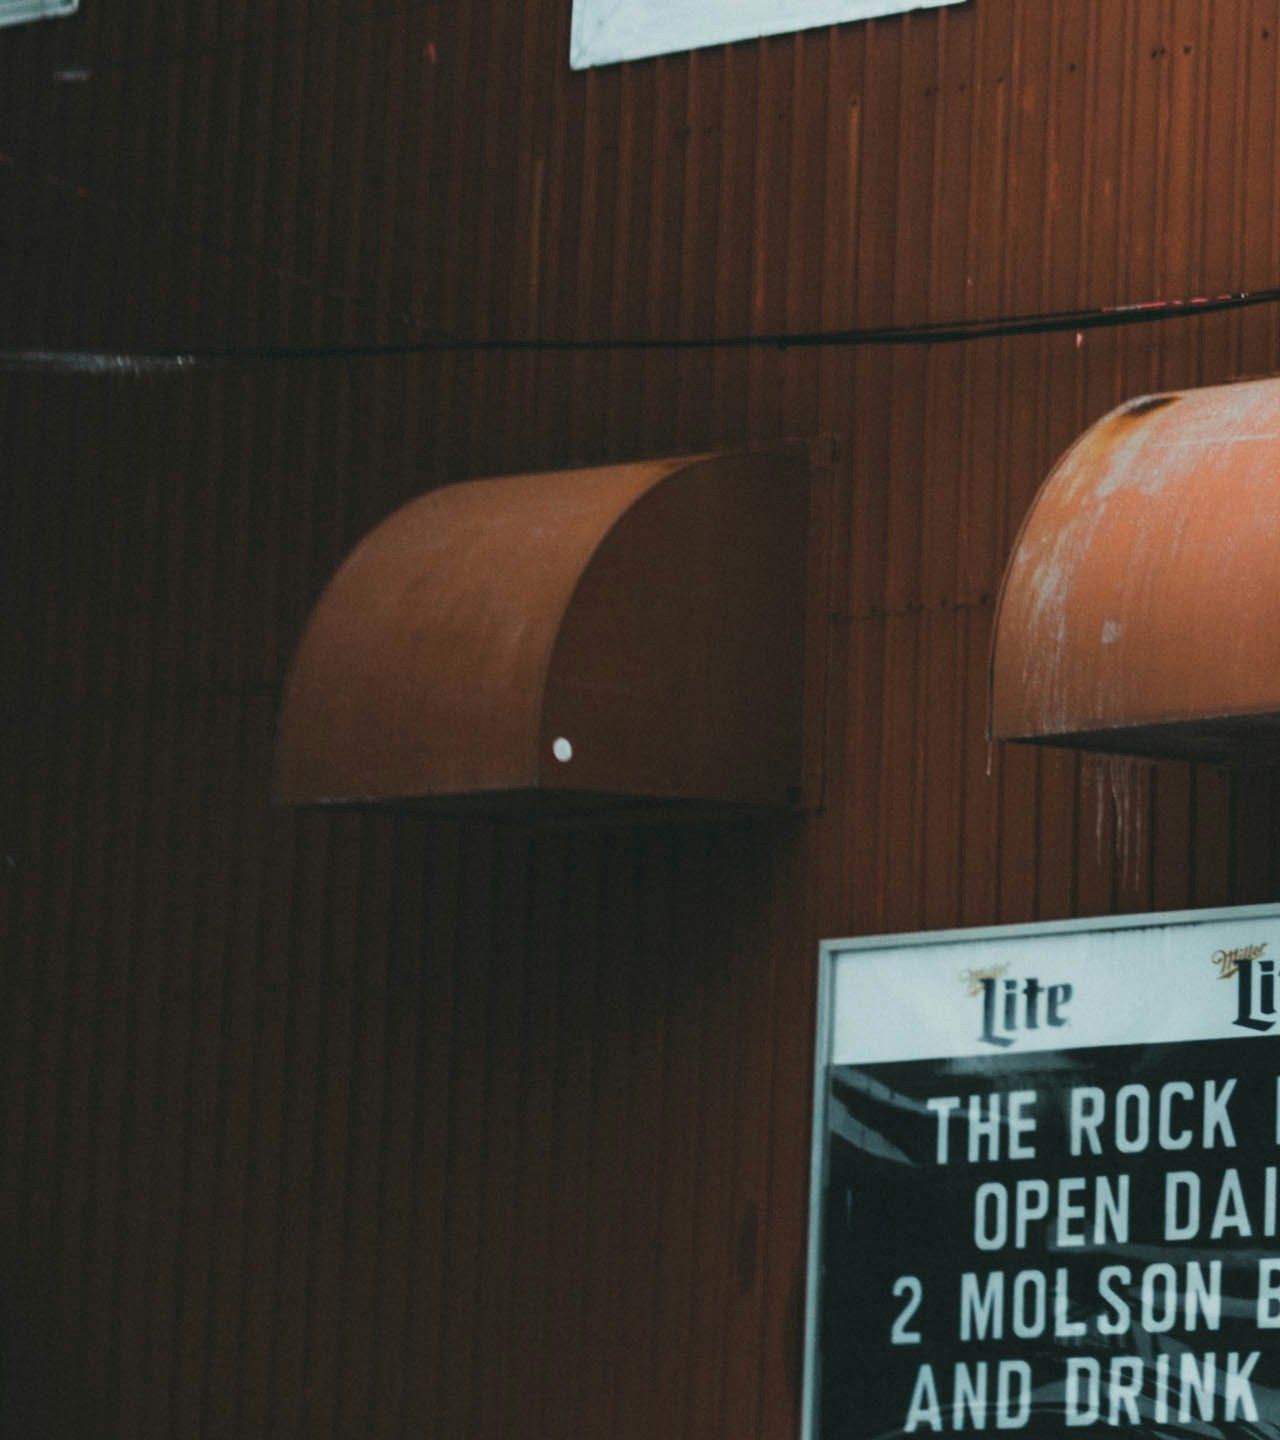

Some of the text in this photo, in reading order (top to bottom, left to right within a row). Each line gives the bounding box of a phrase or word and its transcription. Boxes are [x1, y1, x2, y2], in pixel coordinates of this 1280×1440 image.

[1212, 942, 1268, 979] Miller
[977, 975, 1073, 1047] Lite
[925, 1089, 1038, 1165] THE
[1069, 1078, 1237, 1156] ROCK
[974, 1174, 1130, 1251] OPEN
[891, 1276, 923, 1345] 2
[960, 1260, 1223, 1341] MOLSON
[903, 1360, 1032, 1433] AND
[1064, 1351, 1260, 1426] DRINK
